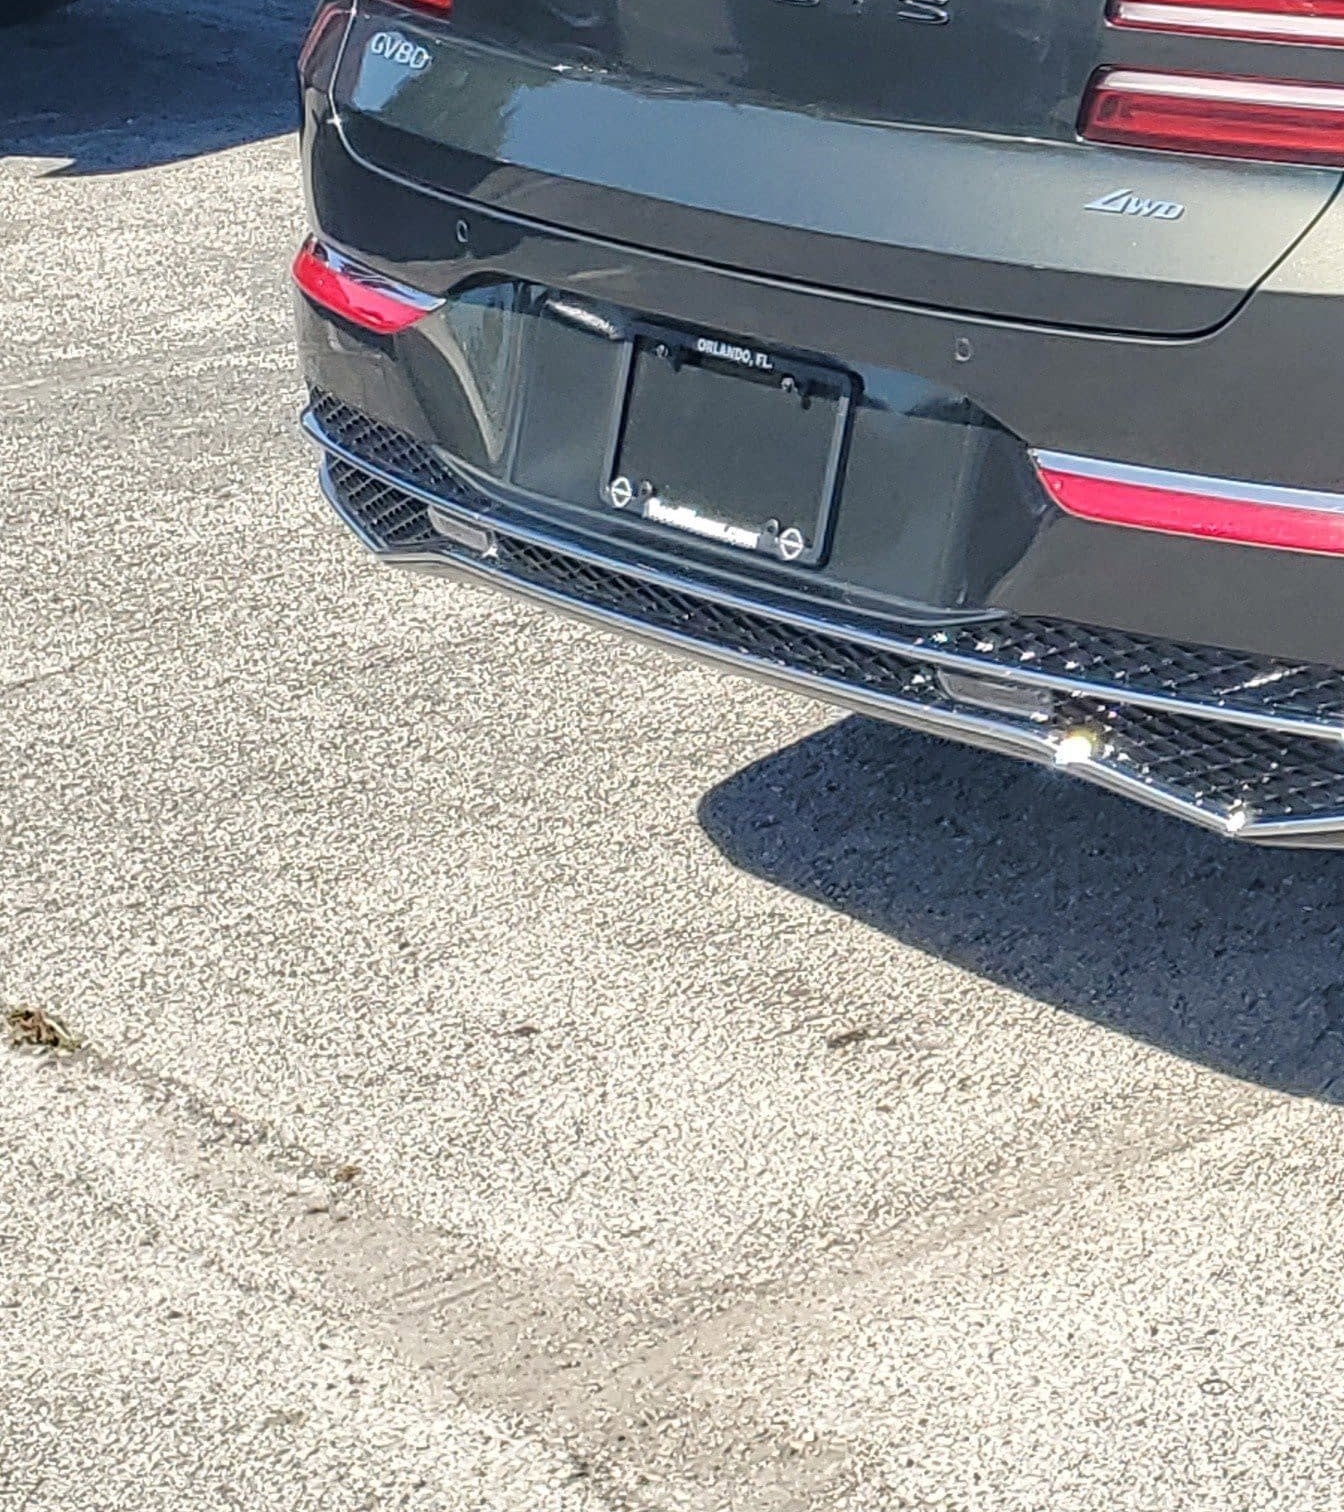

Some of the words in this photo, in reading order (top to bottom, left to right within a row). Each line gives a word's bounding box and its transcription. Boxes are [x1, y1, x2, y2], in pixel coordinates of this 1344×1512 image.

[371, 31, 431, 69] GV80
[1083, 188, 1186, 220] 4WD
[697, 338, 754, 367] ORLANDO,
